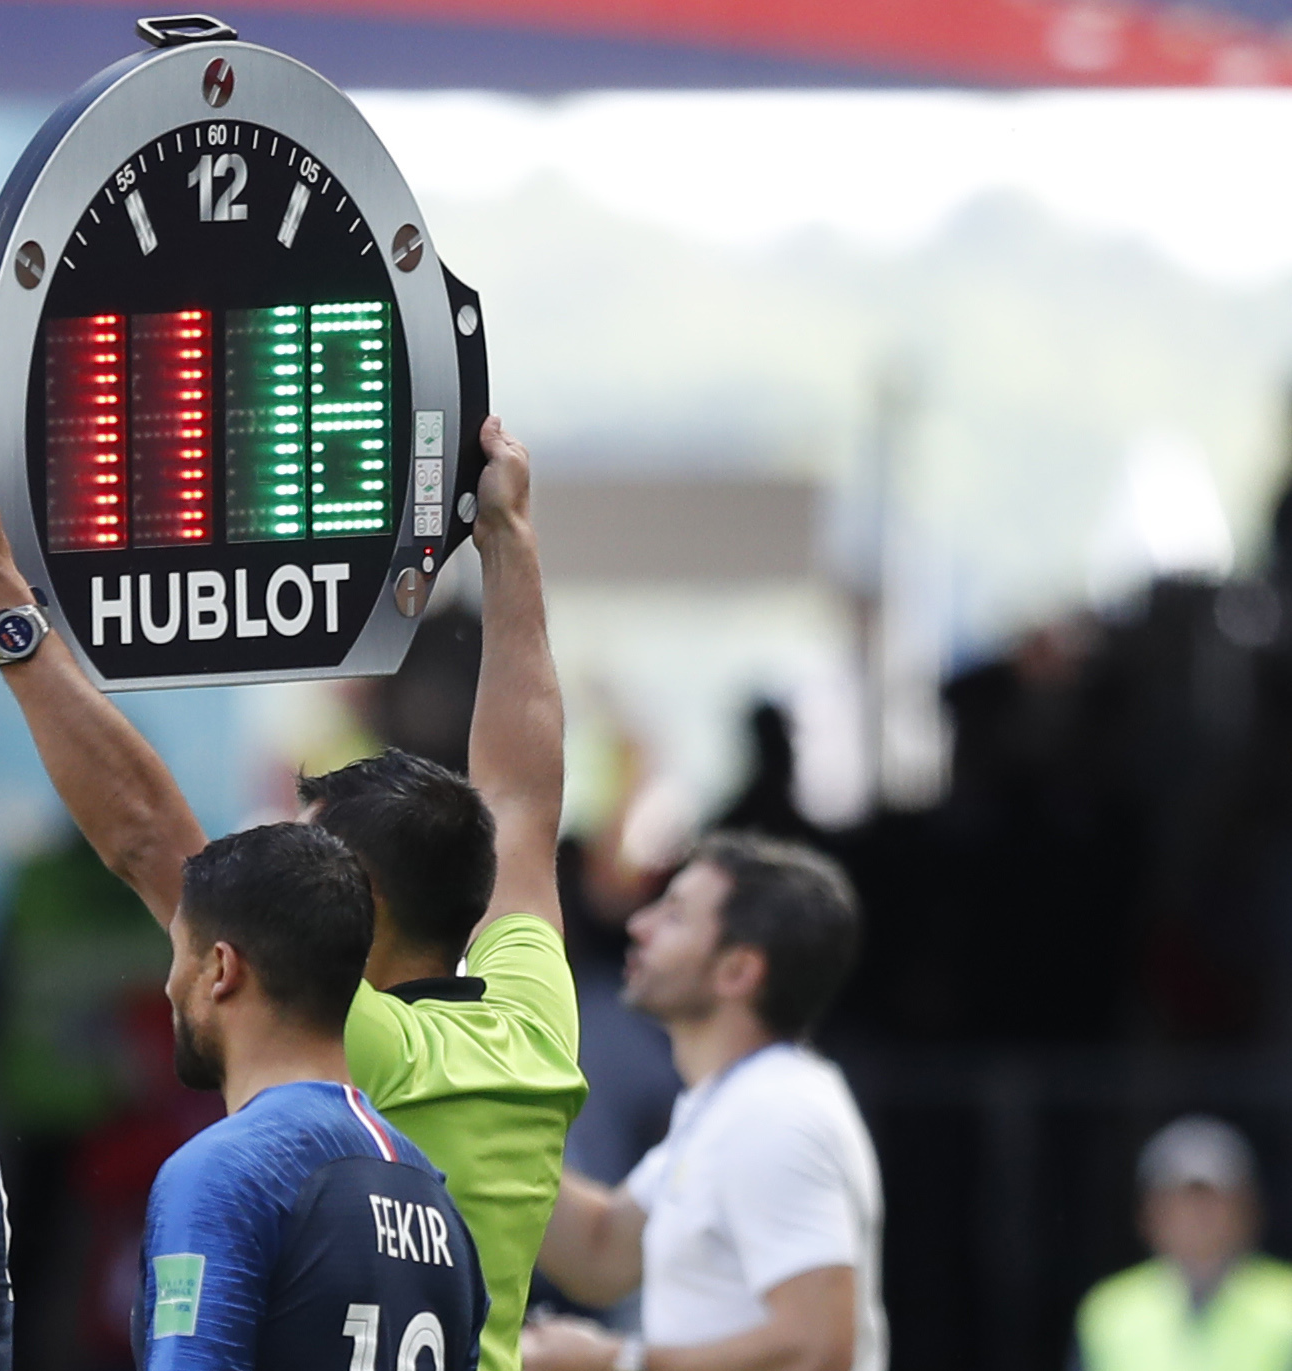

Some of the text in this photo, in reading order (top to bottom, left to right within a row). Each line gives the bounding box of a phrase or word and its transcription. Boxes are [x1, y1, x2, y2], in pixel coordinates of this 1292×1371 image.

[207, 124, 227, 145] 60
[115, 163, 136, 191] 55
[187, 153, 248, 222] 12
[299, 156, 321, 183] 05
[92, 302, 383, 544] 11 18
[90, 562, 351, 646] HUBLOT
[368, 1193, 454, 1268] FEKIR
